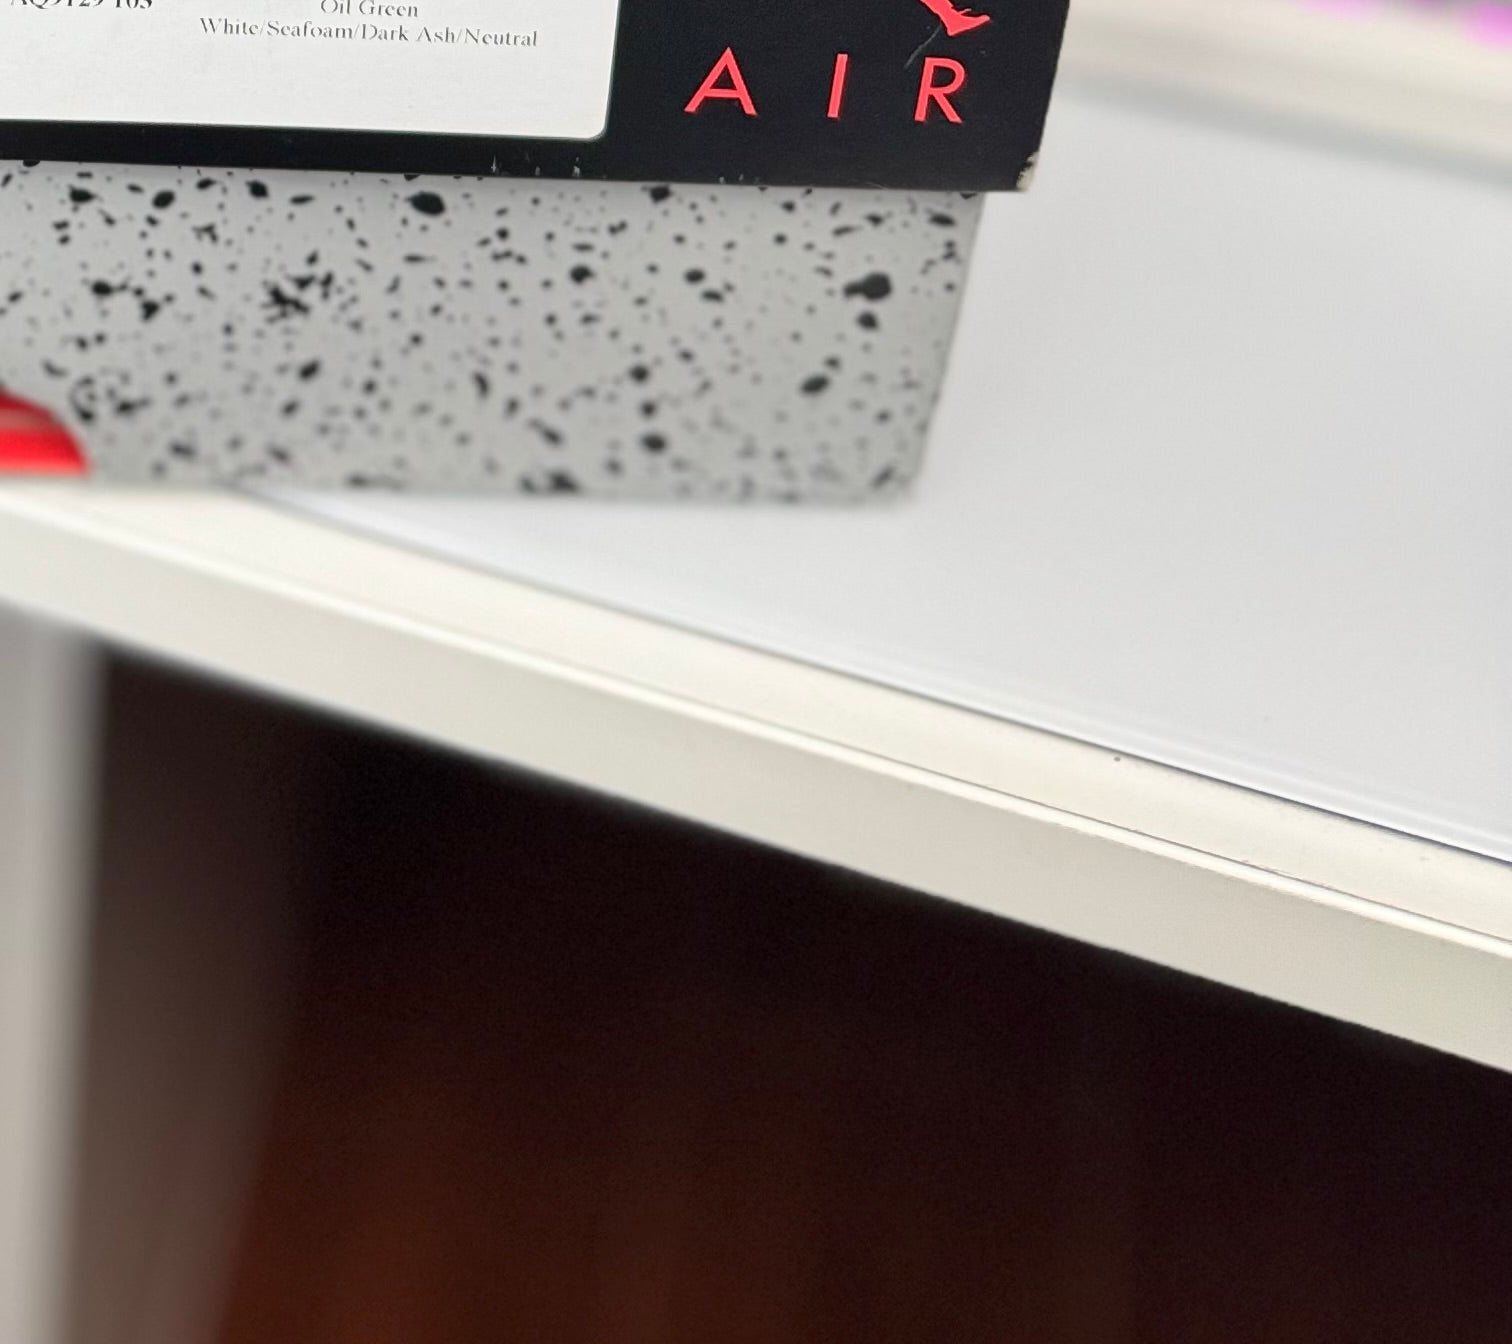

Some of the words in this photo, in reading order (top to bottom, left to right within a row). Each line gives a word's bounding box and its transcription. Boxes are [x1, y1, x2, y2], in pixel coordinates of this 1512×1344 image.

[358, 0, 419, 18] Green
[416, 25, 539, 48] Ash/Neutral
[684, 46, 966, 124] AIR
